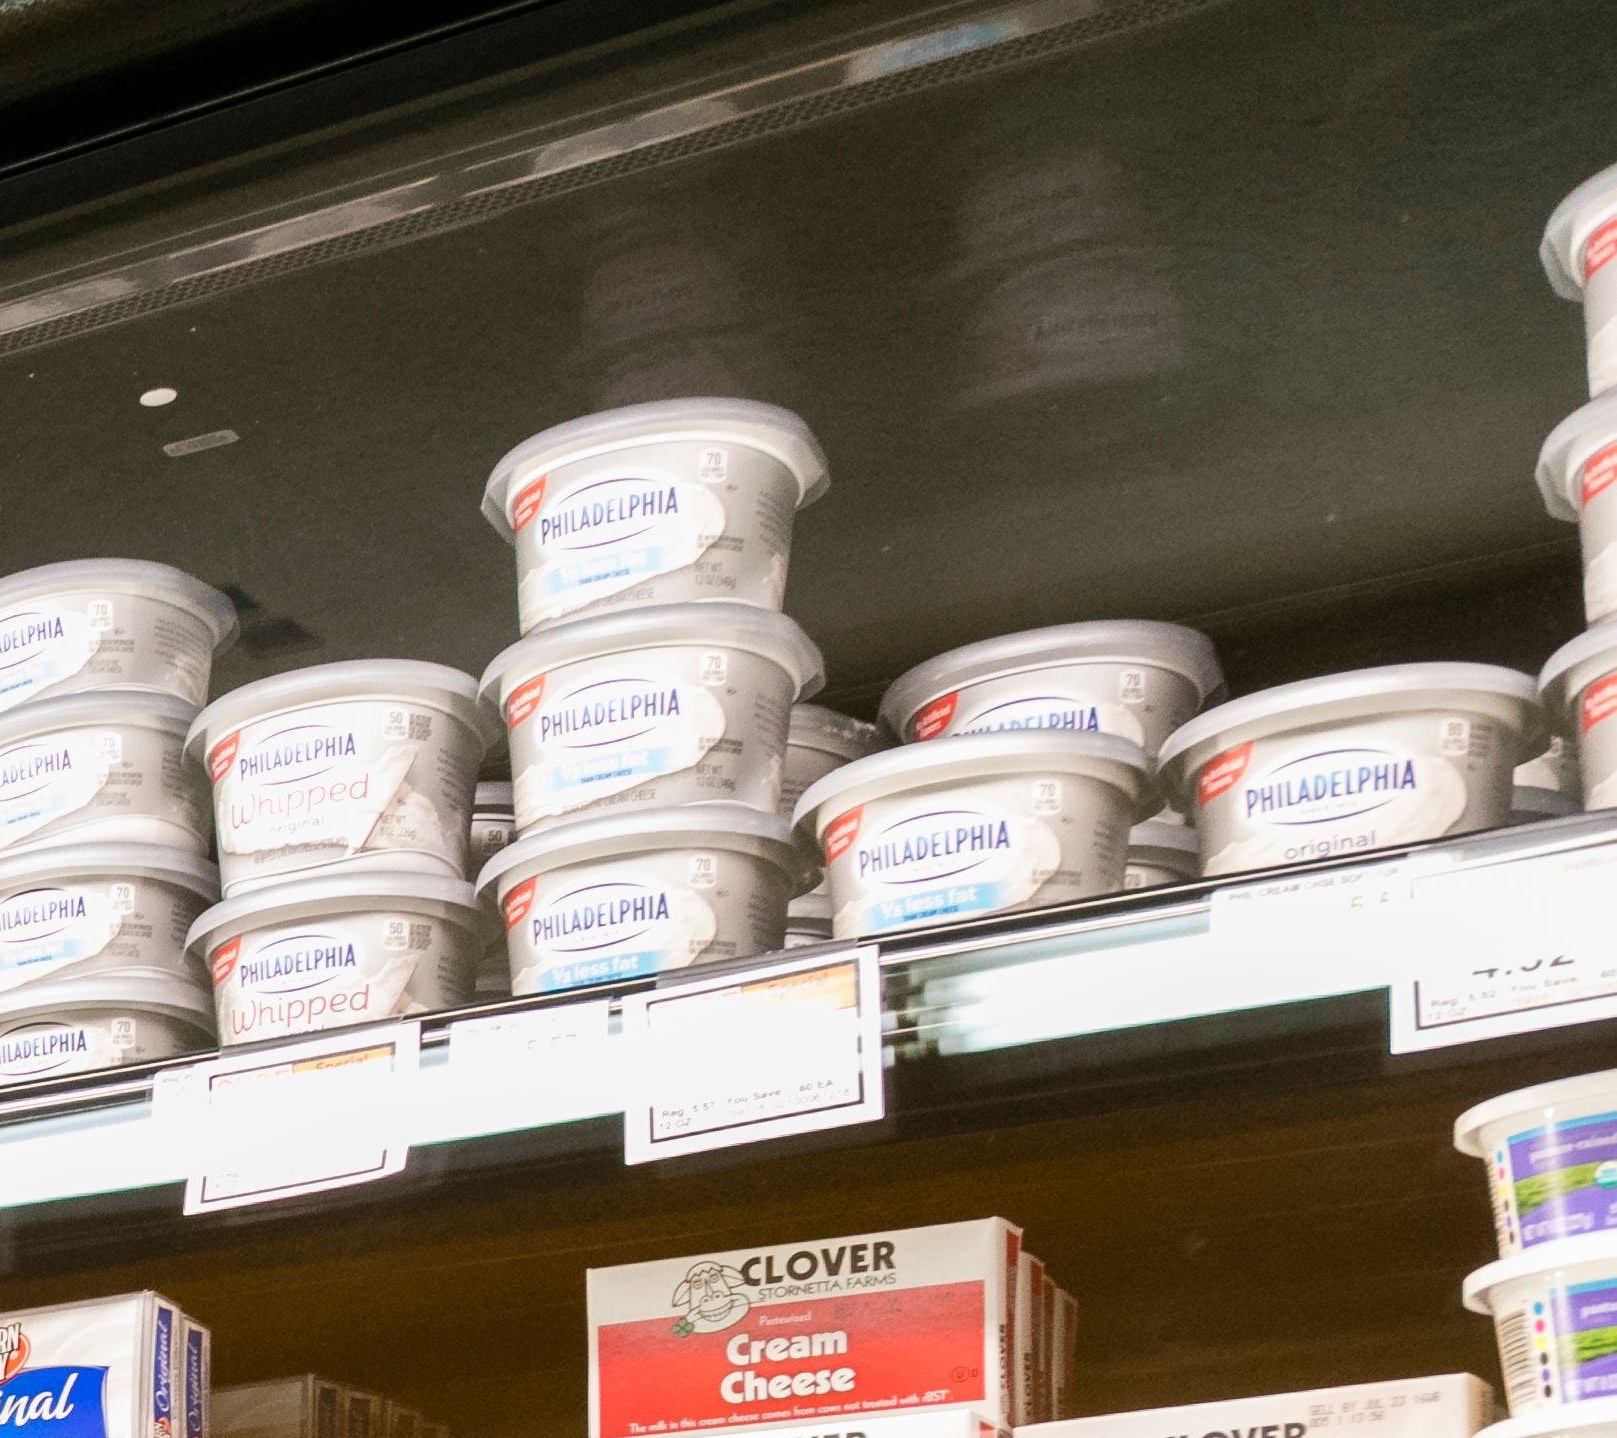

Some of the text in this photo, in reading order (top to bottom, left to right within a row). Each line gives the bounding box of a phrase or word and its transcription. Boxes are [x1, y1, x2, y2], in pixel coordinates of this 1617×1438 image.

[540, 487, 679, 546] PHILADELPHIA
[239, 732, 357, 781] PHILADELPHIA
[230, 773, 370, 830] Whipped
[1246, 759, 1417, 818] PHILADELPHIA
[858, 820, 1011, 878] PHILADELPHIA
[1283, 830, 1377, 861] original
[739, 1239, 897, 1288] CLOVER
[757, 1272, 897, 1301] STORNETTA FARMS
[726, 1328, 848, 1366] Cream
[720, 1365, 856, 1404] Cheese
[629, 1423, 646, 1434] The
[670, 1420, 679, 1429] in
[680, 1418, 697, 1429] this
[698, 1417, 726, 1427] cream
[728, 1412, 760, 1425] cheese
[762, 1409, 791, 1421] comes
[793, 1405, 816, 1417] from
[817, 1405, 841, 1415] cows
[843, 1401, 861, 1411] not
[862, 1396, 897, 1409] treated
[899, 1394, 920, 1406] with
